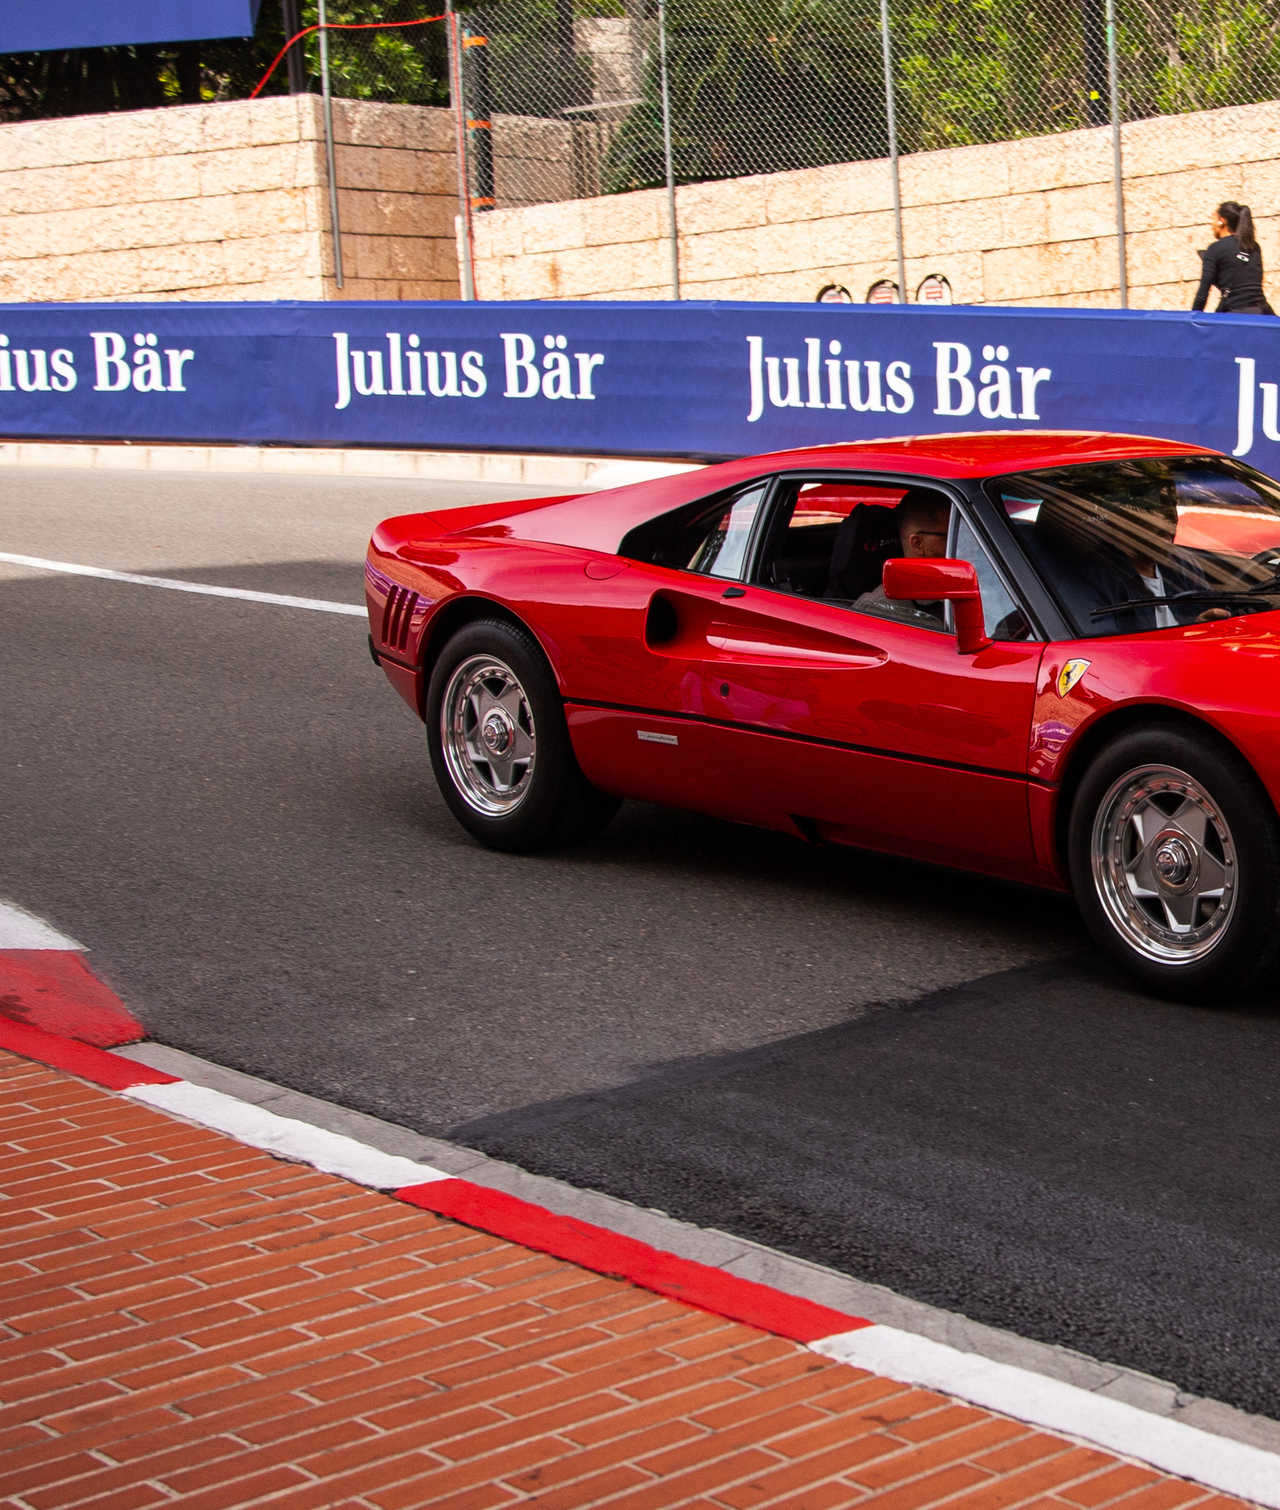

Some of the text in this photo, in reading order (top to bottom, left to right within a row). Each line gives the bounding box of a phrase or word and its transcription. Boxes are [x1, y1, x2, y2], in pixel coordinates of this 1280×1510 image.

[90, 332, 195, 393] Bär
[332, 332, 605, 410] Julius Bär
[746, 335, 1052, 422] Julius Bär
